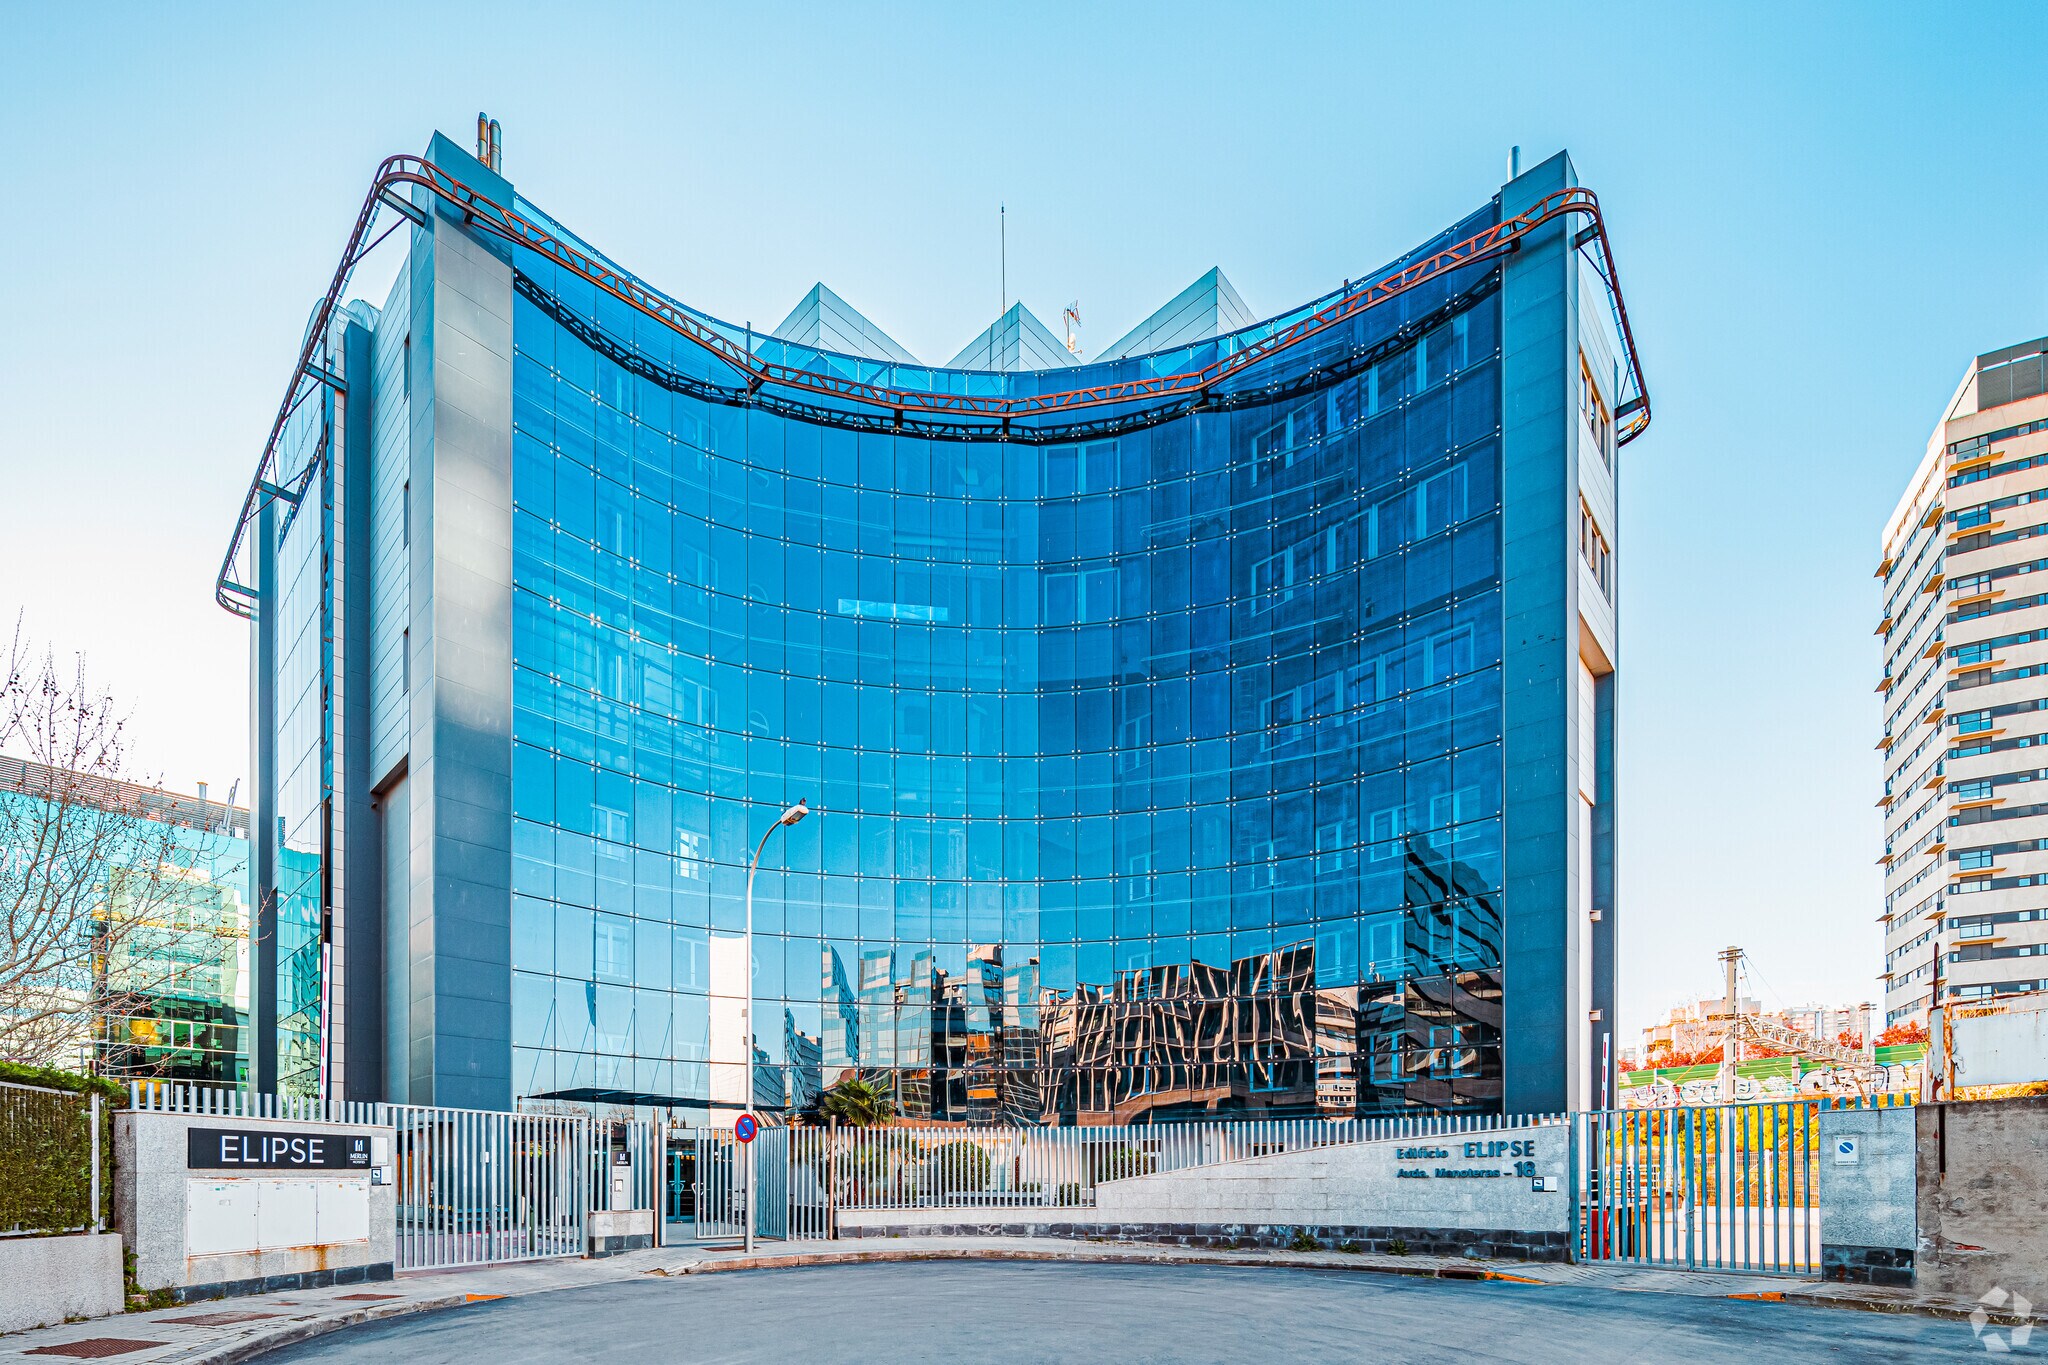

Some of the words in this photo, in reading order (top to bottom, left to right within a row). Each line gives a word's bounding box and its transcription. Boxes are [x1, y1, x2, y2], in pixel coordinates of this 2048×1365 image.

[220, 1135, 325, 1164] ELIPSE
[1396, 1147, 1449, 1159] Edificio
[1464, 1140, 1535, 1158] ELIPSE
[1435, 1168, 1501, 1178] Manoteras
[1513, 1161, 1536, 1178] 18
